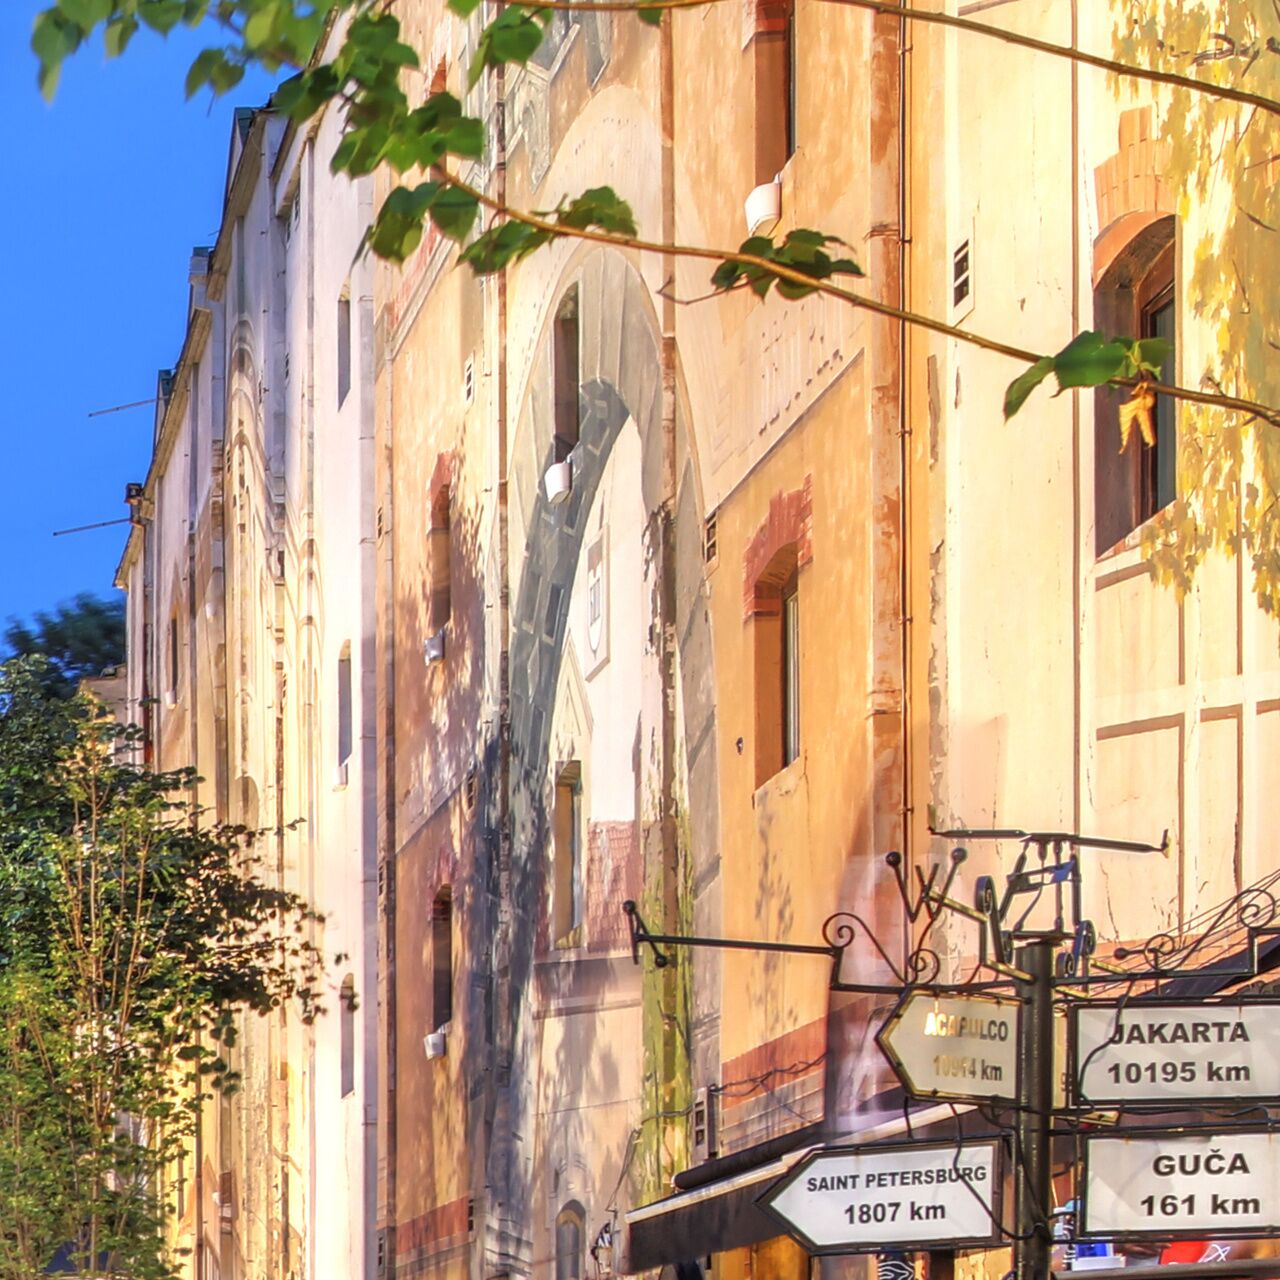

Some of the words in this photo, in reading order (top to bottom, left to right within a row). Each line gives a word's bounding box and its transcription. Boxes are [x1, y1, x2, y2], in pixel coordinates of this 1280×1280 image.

[924, 1012, 1009, 1041] ACAPULCO
[1109, 1021, 1250, 1044] JAKARTA
[981, 1058, 1003, 1081] km
[1108, 1061, 1196, 1084] 10195
[1206, 1061, 1251, 1082] km
[1152, 1149, 1250, 1176] GUČA
[807, 1174, 860, 1192] SAINT
[865, 1166, 987, 1188] PETERSBURG
[844, 1202, 901, 1225] 1807
[910, 1201, 946, 1221] km
[1140, 1194, 1196, 1216] 161
[1211, 1194, 1260, 1215] km
